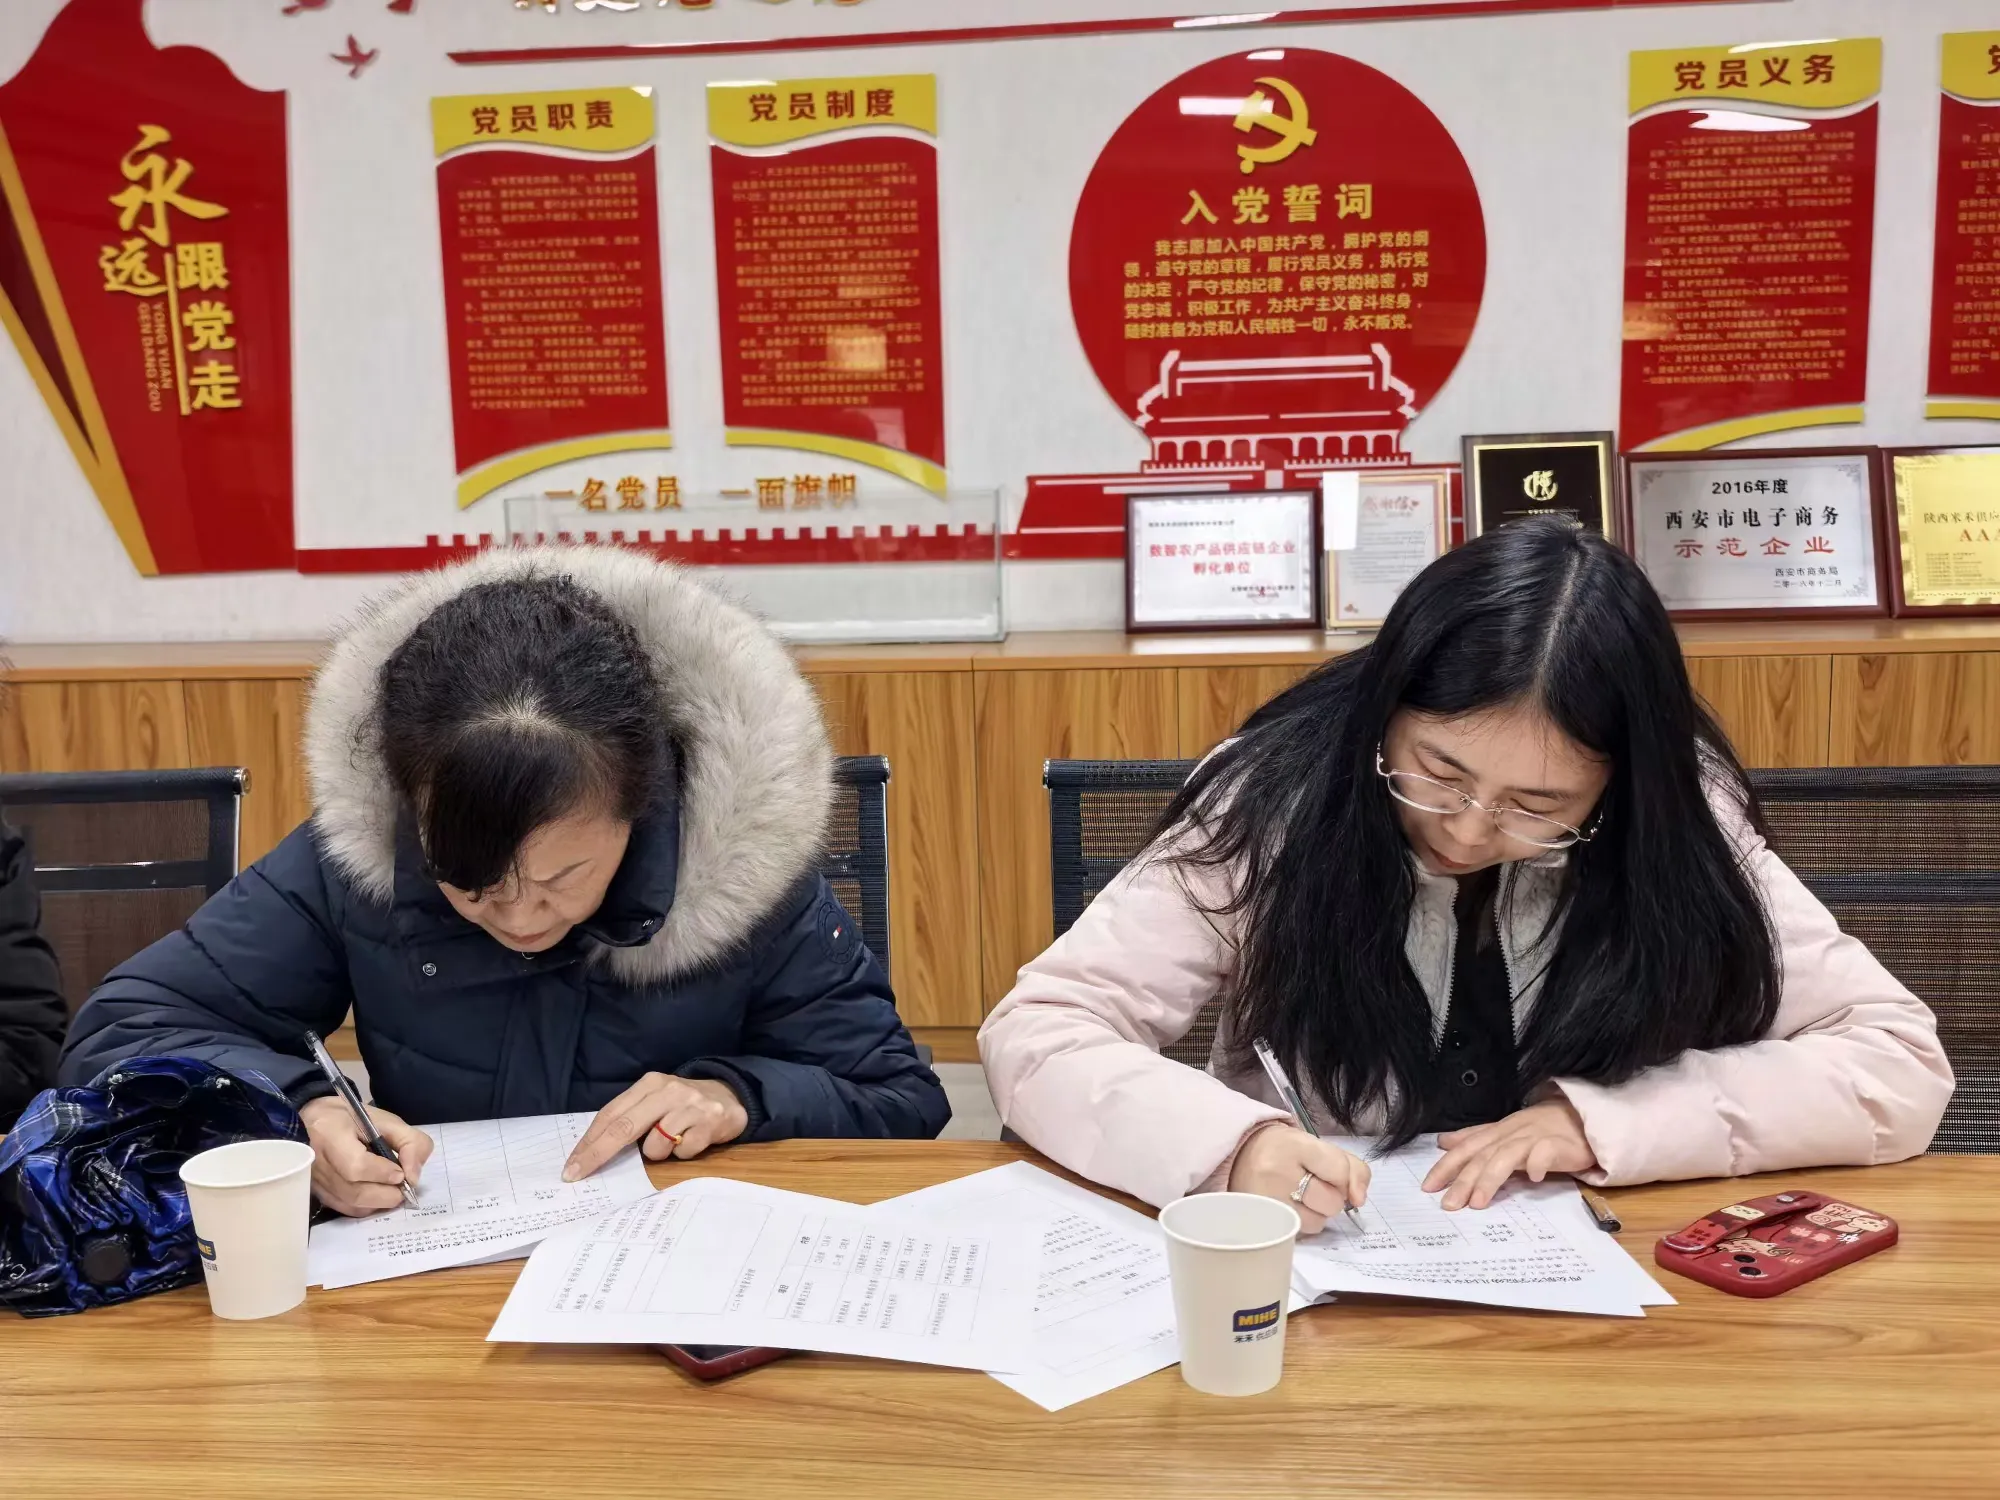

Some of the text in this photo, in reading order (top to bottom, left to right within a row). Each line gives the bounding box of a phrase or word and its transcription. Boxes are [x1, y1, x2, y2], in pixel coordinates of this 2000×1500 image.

[1674, 54, 1837, 92] 党员义务
[471, 100, 615, 135] 党员职责
[748, 88, 897, 123] 党员制度
[1181, 184, 1373, 225] 入党誓词
[175, 242, 242, 410] 跟党走
[544, 473, 858, 512] 一名党员 一面旗帜
[1711, 478, 1790, 495] 2016年度
[1664, 506, 1840, 530] 西安市电子商务
[1673, 536, 1835, 559] 示范企业
[1238, 1307, 1278, 1327] MIHE
